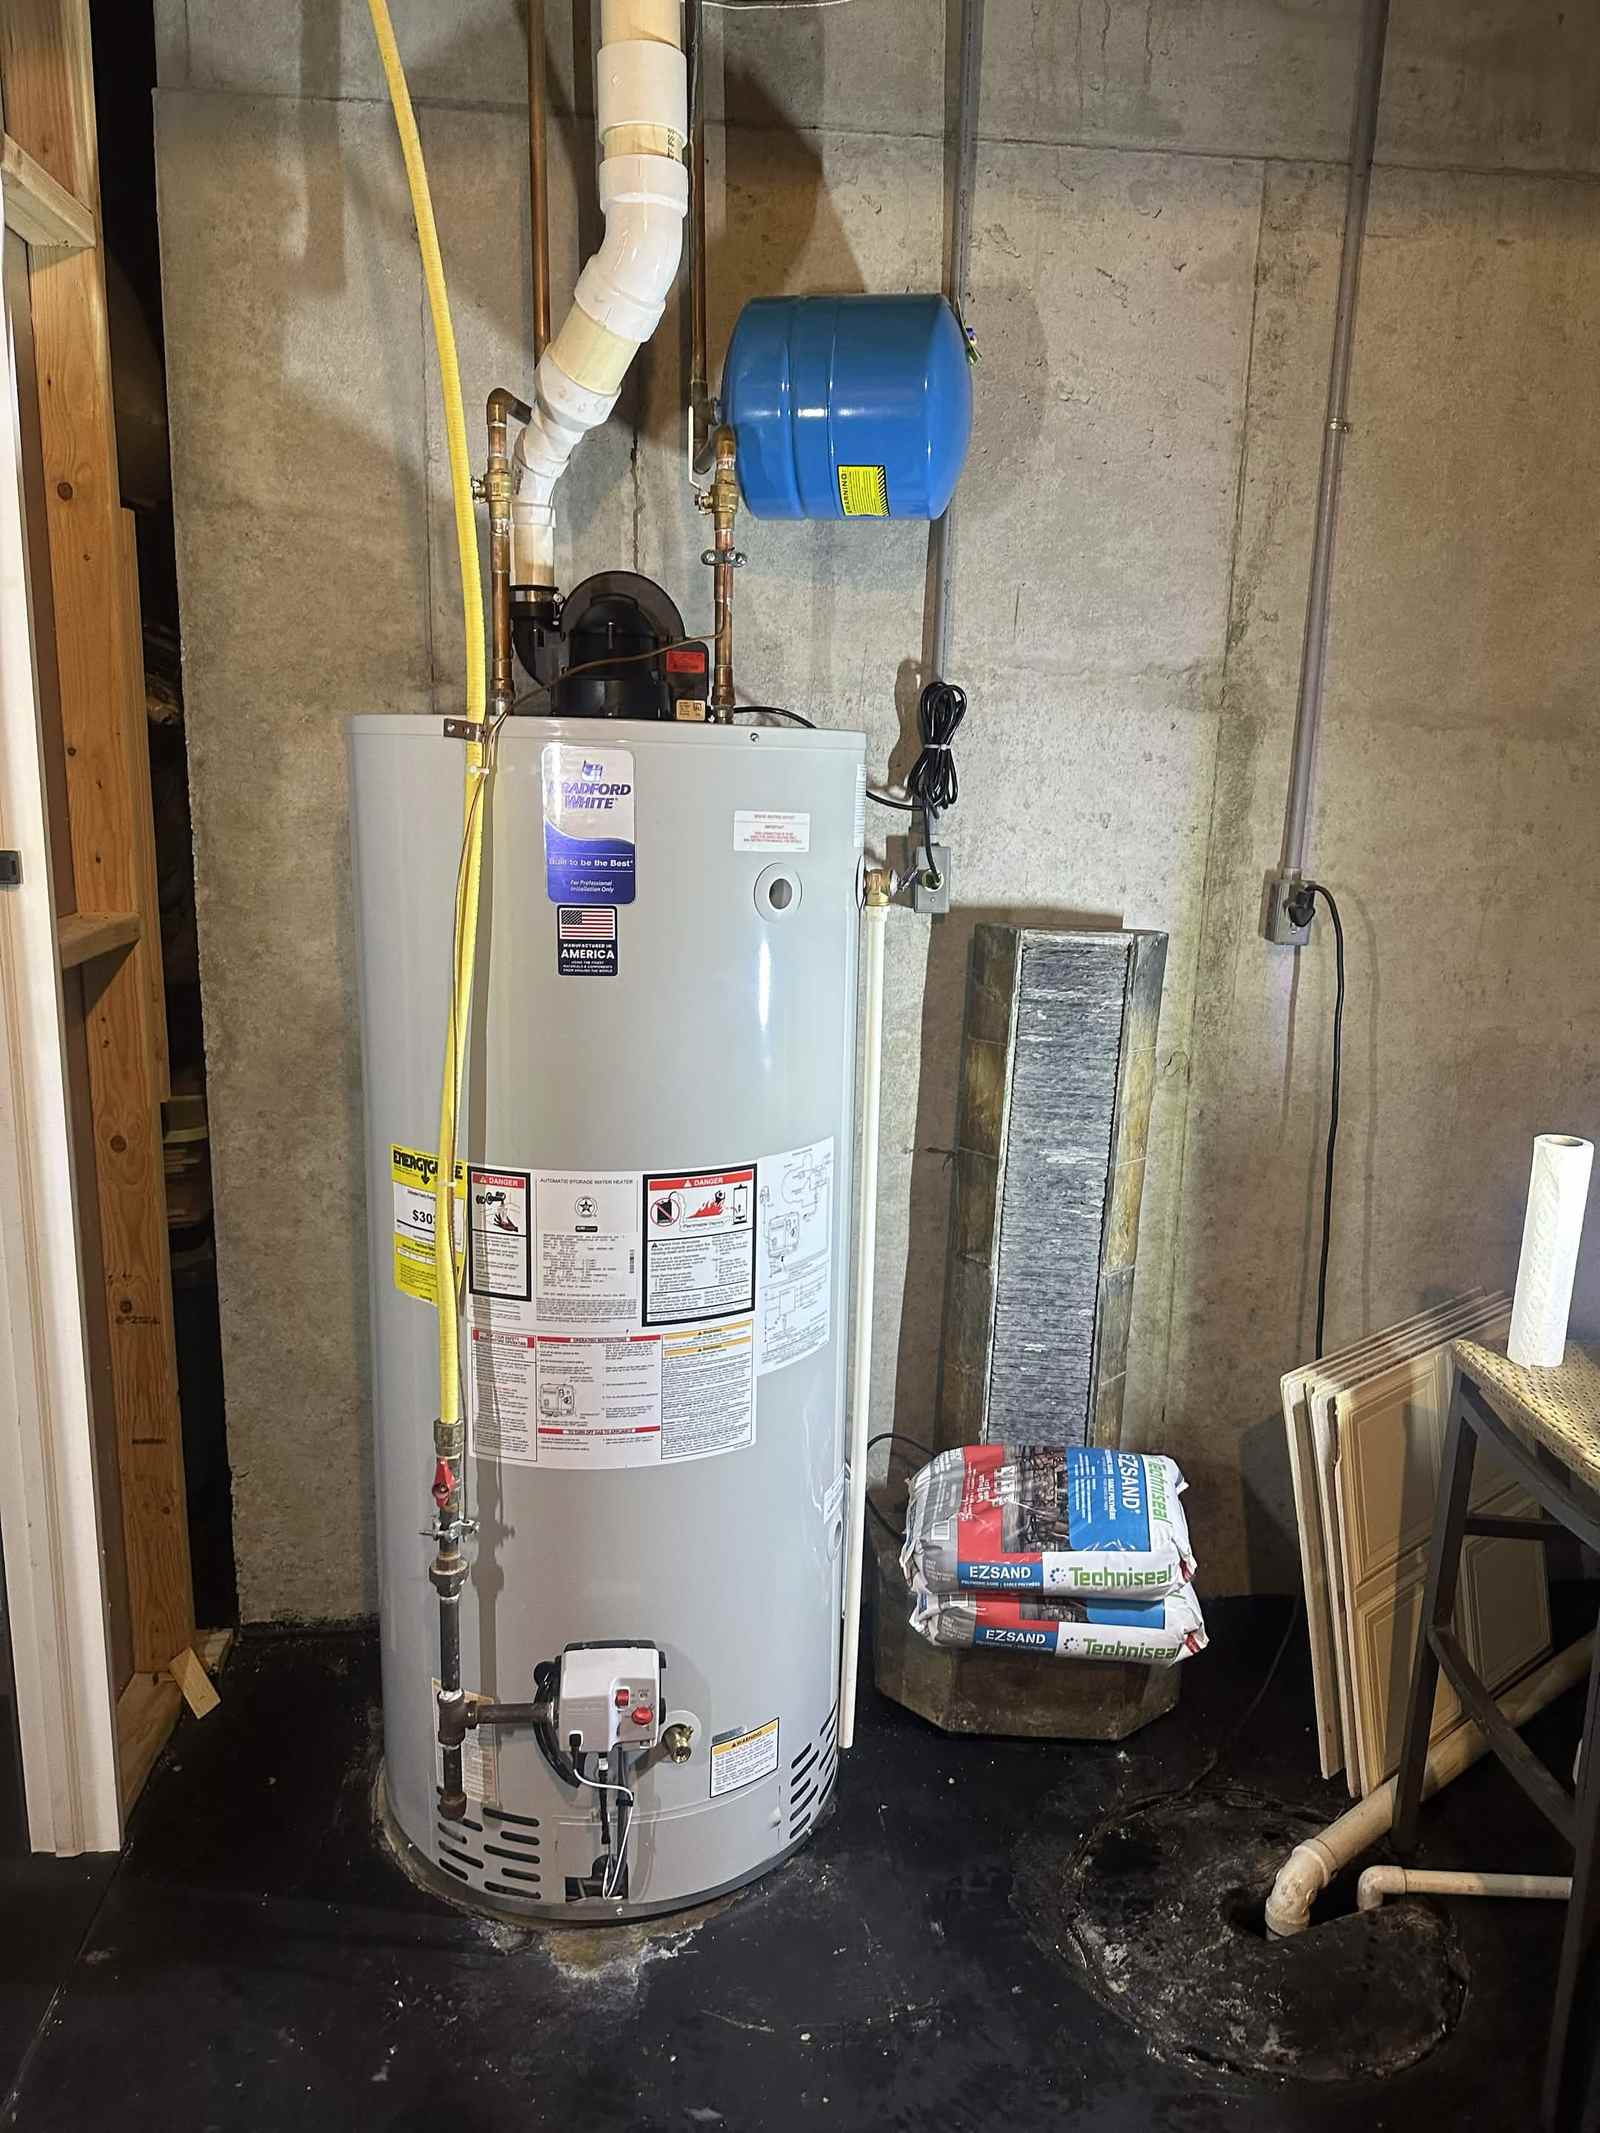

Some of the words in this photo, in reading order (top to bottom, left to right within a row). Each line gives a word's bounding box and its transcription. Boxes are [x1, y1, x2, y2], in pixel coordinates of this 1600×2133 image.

[580, 858, 592, 866] be
[594, 859, 608, 867] the
[601, 886, 614, 894] Only
[561, 949, 615, 960] AMERICA
[489, 1178, 519, 1187] DANGER
[694, 1177, 724, 1187] DANGER
[412, 1209, 436, 1225] $30
[1118, 1453, 1139, 1509] EZSAND
[969, 1565, 1031, 1579] EZSAND
[1069, 1564, 1172, 1586] Techniseal
[986, 1629, 1046, 1644] EZSAND
